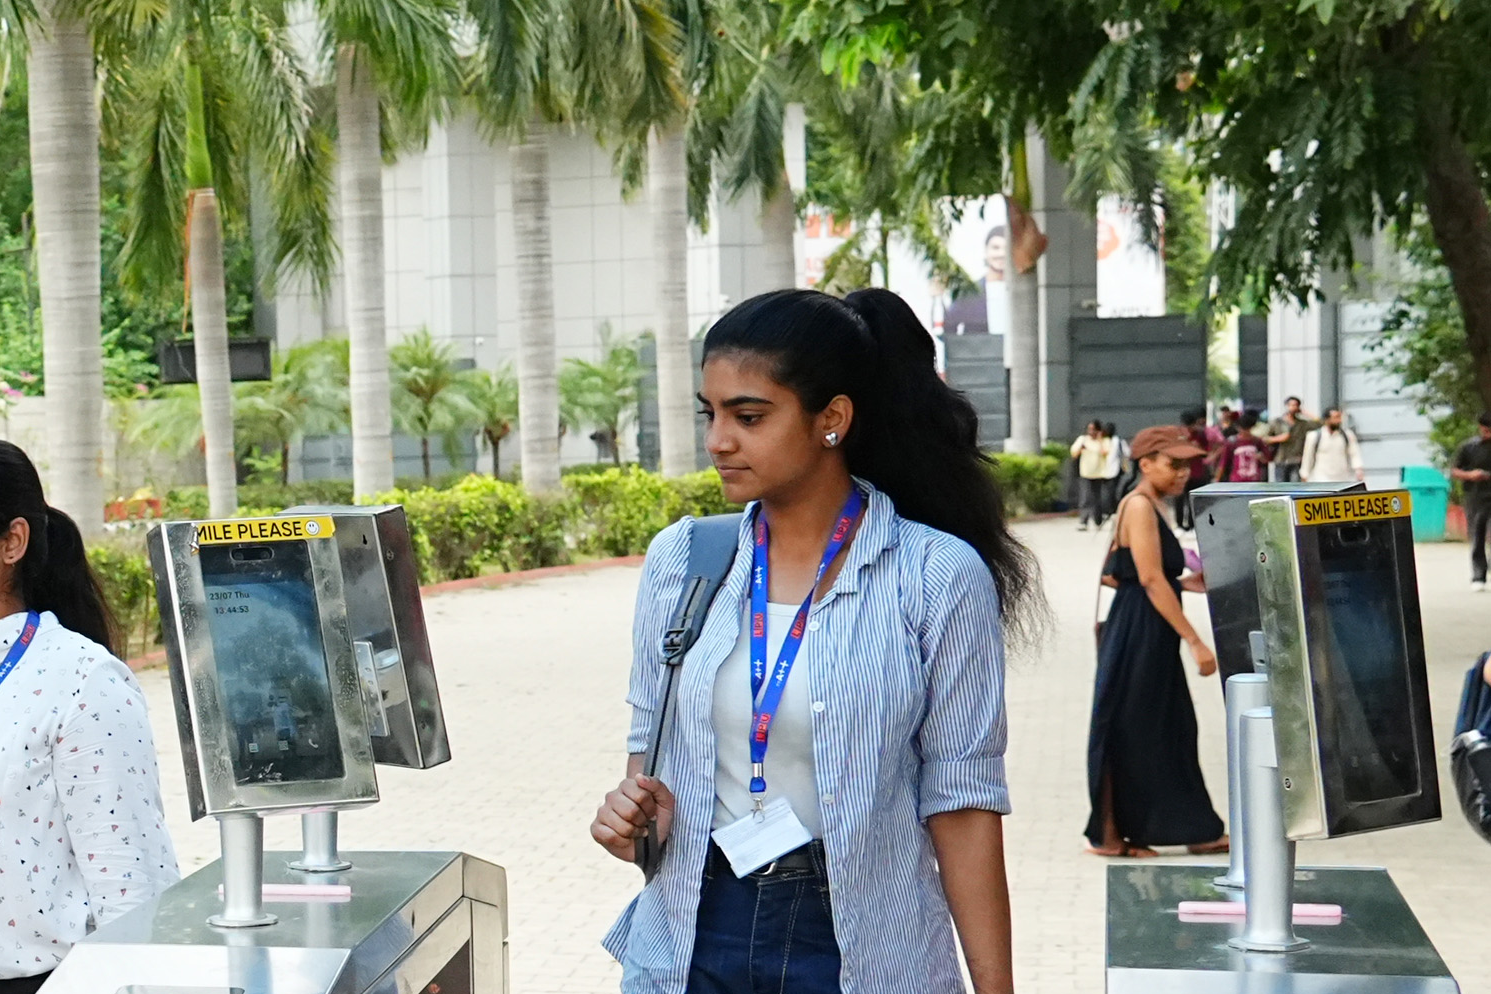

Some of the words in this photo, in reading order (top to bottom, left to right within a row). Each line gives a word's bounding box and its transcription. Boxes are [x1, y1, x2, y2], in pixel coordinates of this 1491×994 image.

[1304, 500, 1341, 521] SMILE
[1343, 497, 1390, 518] PLEASE
[197, 524, 233, 541] MILE
[237, 521, 303, 539] PLEASE
[833, 517, 851, 542] LPU
[209, 592, 232, 601] 23/07
[234, 591, 250, 599] Thu
[214, 605, 250, 615] 13:44:53
[753, 613, 763, 637] LPU
[753, 659, 763, 680] A++
[776, 660, 789, 682] A++
